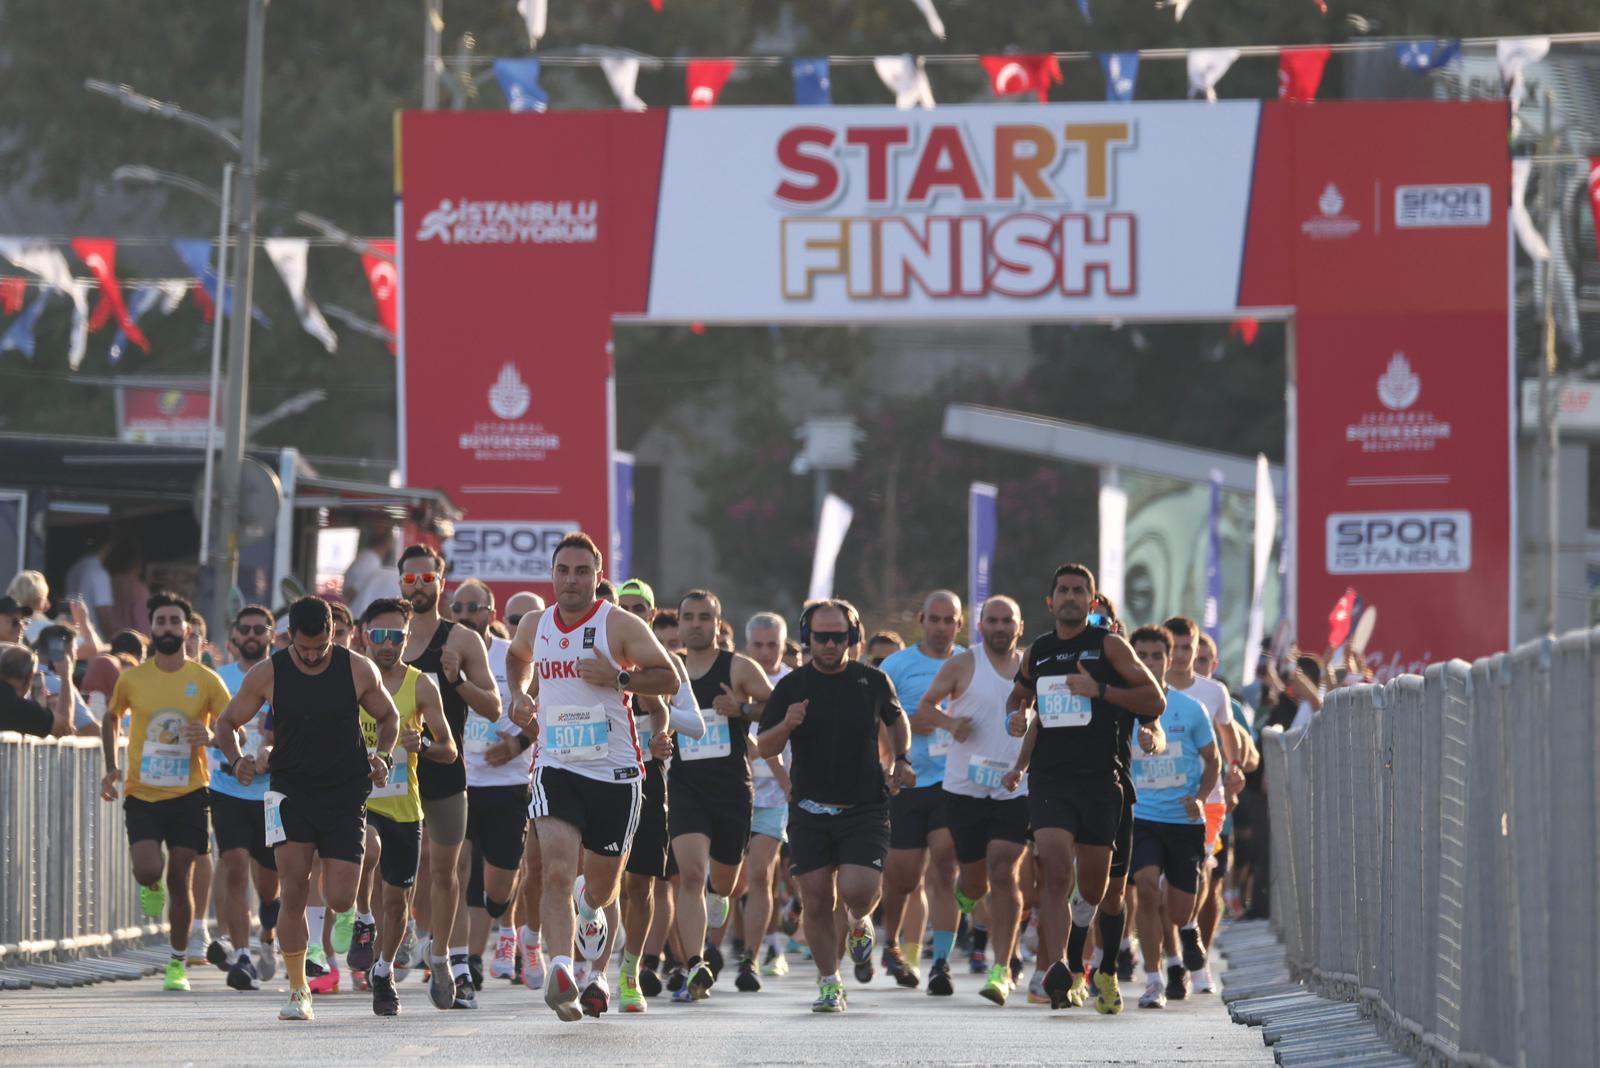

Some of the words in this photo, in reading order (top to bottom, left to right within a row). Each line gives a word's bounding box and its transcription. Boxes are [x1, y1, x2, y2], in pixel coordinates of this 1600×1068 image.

[774, 122, 1133, 207] START
[780, 212, 1137, 299] FINISH
[1337, 518, 1457, 545] SPOR
[555, 724, 596, 748] 5071
